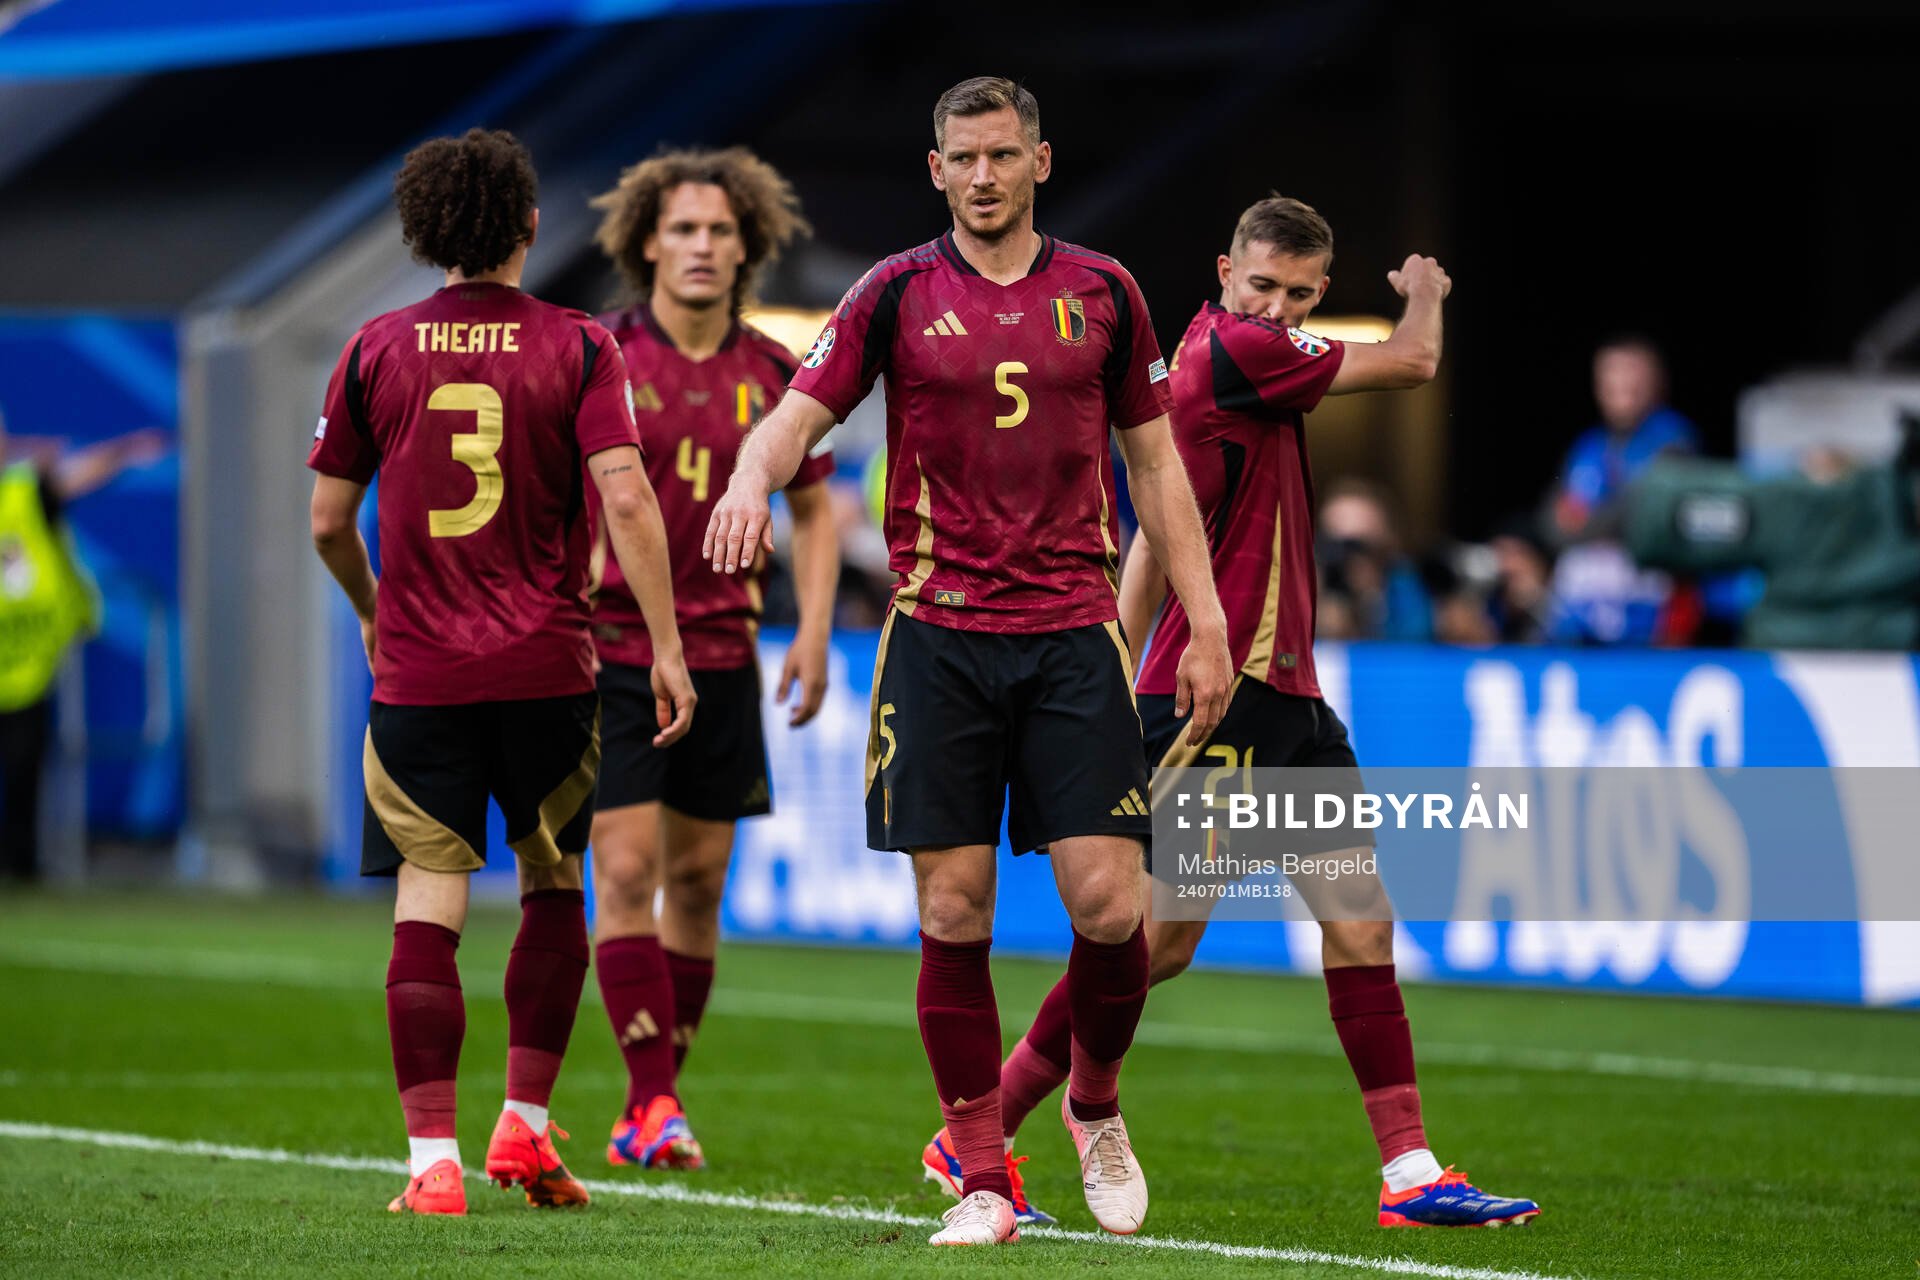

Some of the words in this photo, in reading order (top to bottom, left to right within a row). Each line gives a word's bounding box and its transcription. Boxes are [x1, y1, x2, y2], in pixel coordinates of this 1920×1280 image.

[414, 322, 521, 353] THEATE
[994, 361, 1030, 429] 5
[427, 382, 504, 538] 3
[676, 436, 711, 502] 4
[879, 702, 897, 770] 5
[1203, 744, 1253, 808] 21
